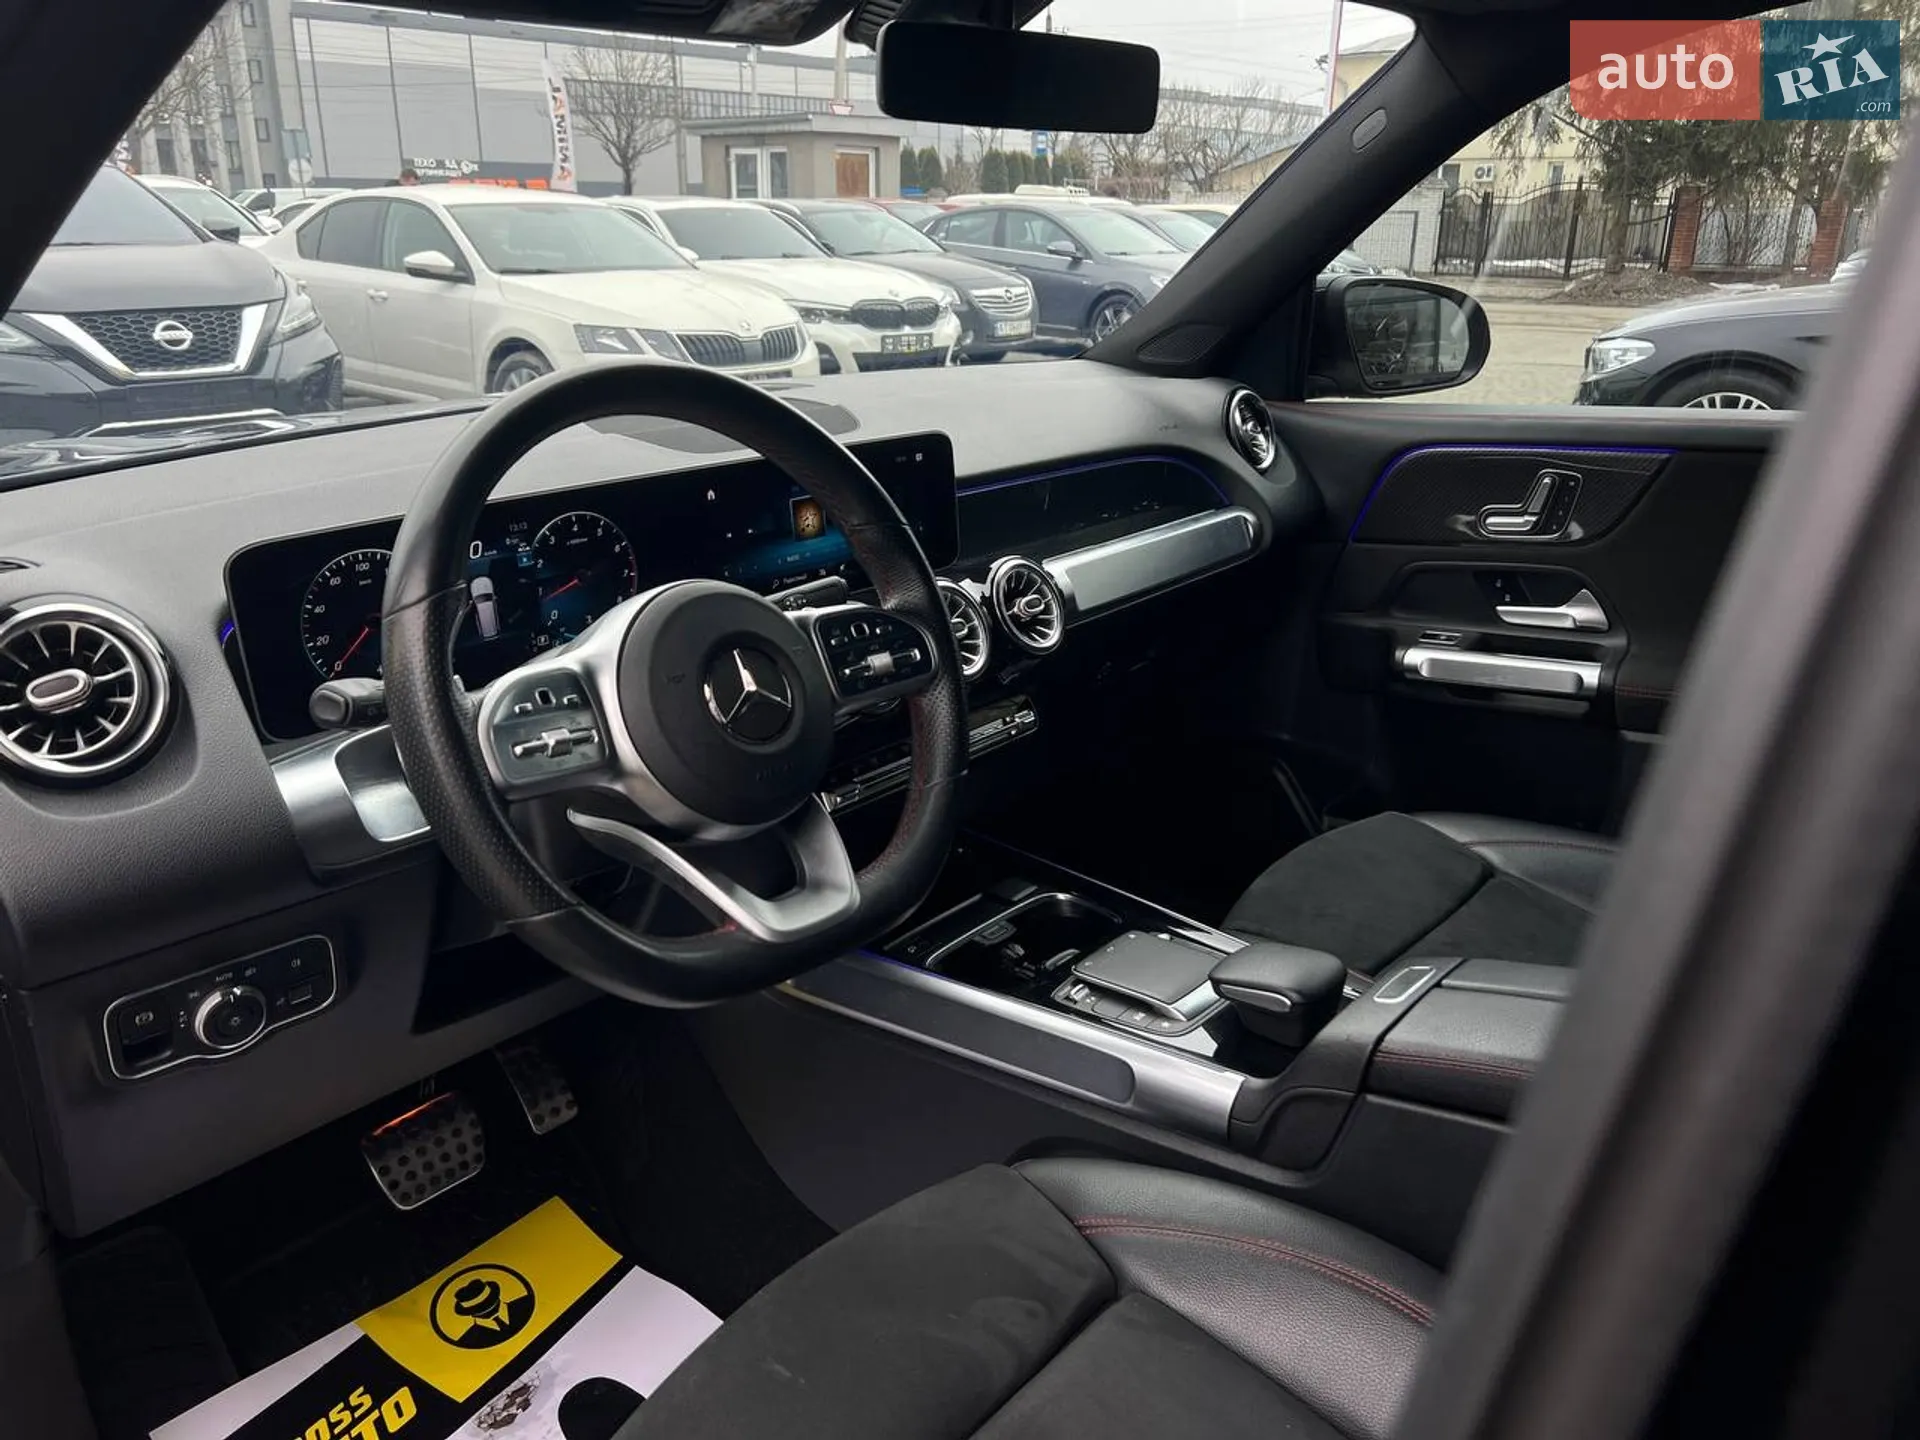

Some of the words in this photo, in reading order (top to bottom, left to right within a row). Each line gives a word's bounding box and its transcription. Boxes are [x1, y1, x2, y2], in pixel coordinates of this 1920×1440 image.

[469, 540, 483, 560] 0
[314, 605, 325, 613] 40
[316, 635, 330, 645] 20
[293, 1385, 373, 1440] OSS
